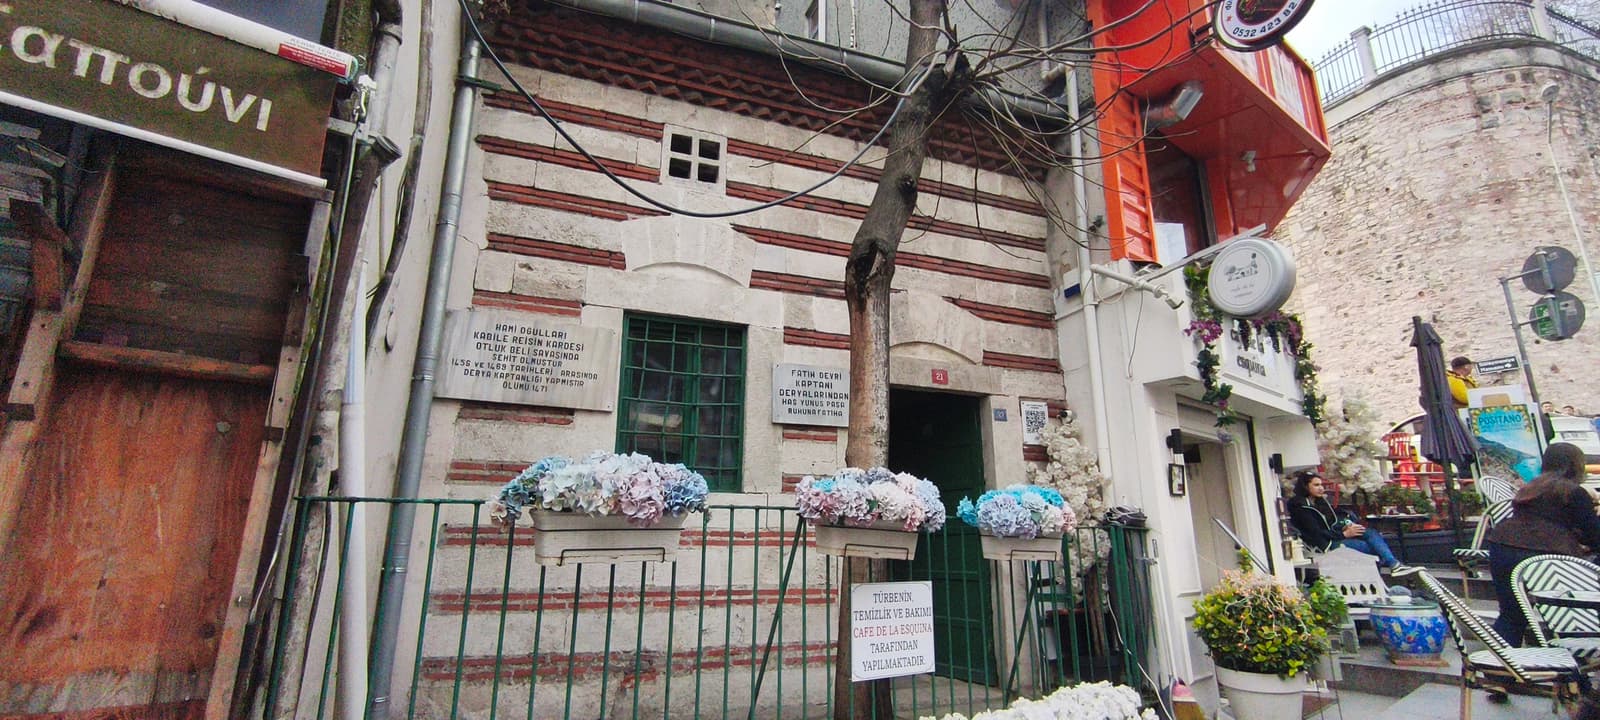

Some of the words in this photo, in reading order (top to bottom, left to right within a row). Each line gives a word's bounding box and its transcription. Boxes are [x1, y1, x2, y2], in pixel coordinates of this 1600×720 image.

[1232, 26, 1257, 38] 0532
[1260, 17, 1281, 34] 423
[476, 342, 506, 353] OTLUK
[475, 360, 485, 369] VE
[463, 368, 491, 378] DERYA
[779, 388, 849, 400] DERYALARINDAN
[782, 398, 798, 406] HAS
[801, 399, 824, 407] YUNUS
[1478, 414, 1522, 426] POSITANO
[853, 607, 892, 621] TEMİZLİK
[893, 608, 904, 619] VE
[905, 607, 932, 618] BAKIMI
[853, 626, 875, 639] CAFE
[876, 625, 887, 637] DE
[889, 624, 899, 636] LA
[901, 623, 932, 636] ESQUINA
[870, 639, 918, 654] TARAFINDAN
